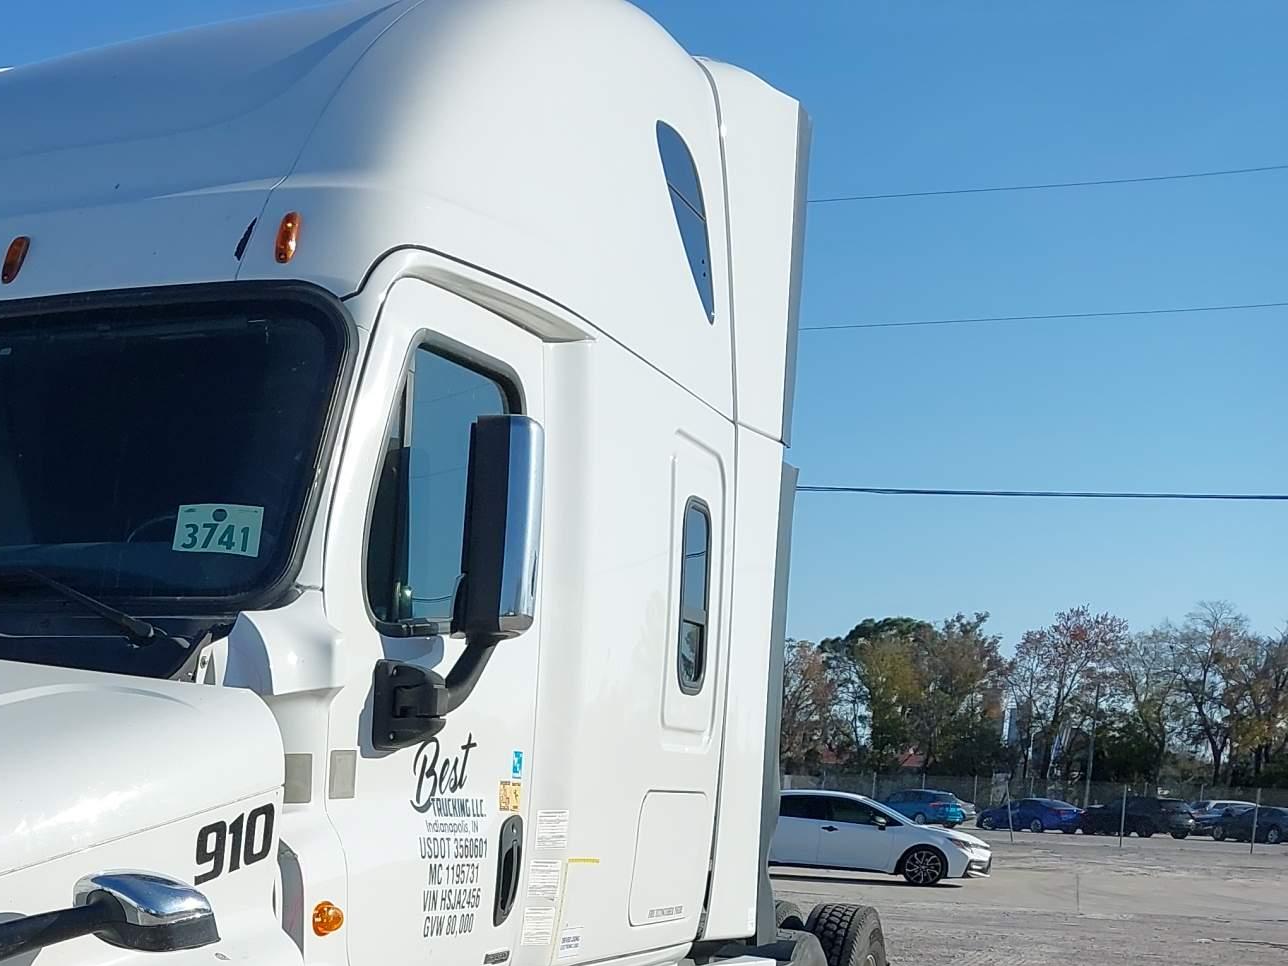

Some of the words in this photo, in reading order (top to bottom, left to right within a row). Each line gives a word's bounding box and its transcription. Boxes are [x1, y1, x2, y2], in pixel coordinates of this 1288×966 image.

[181, 523, 250, 553] 3741
[410, 732, 477, 813] Best
[431, 798, 471, 817] TRUCKING
[425, 820, 471, 835] Indianapolis,
[472, 820, 479, 833] IN
[194, 803, 275, 886] 910
[419, 837, 451, 859] USDOT
[454, 837, 487, 859] 3560601
[429, 863, 443, 885] MC
[446, 863, 479, 884] 1195731
[423, 889, 438, 912] VIN
[440, 888, 481, 911] HSJA2456
[423, 915, 445, 938] GVW
[446, 913, 474, 938] 80,000
